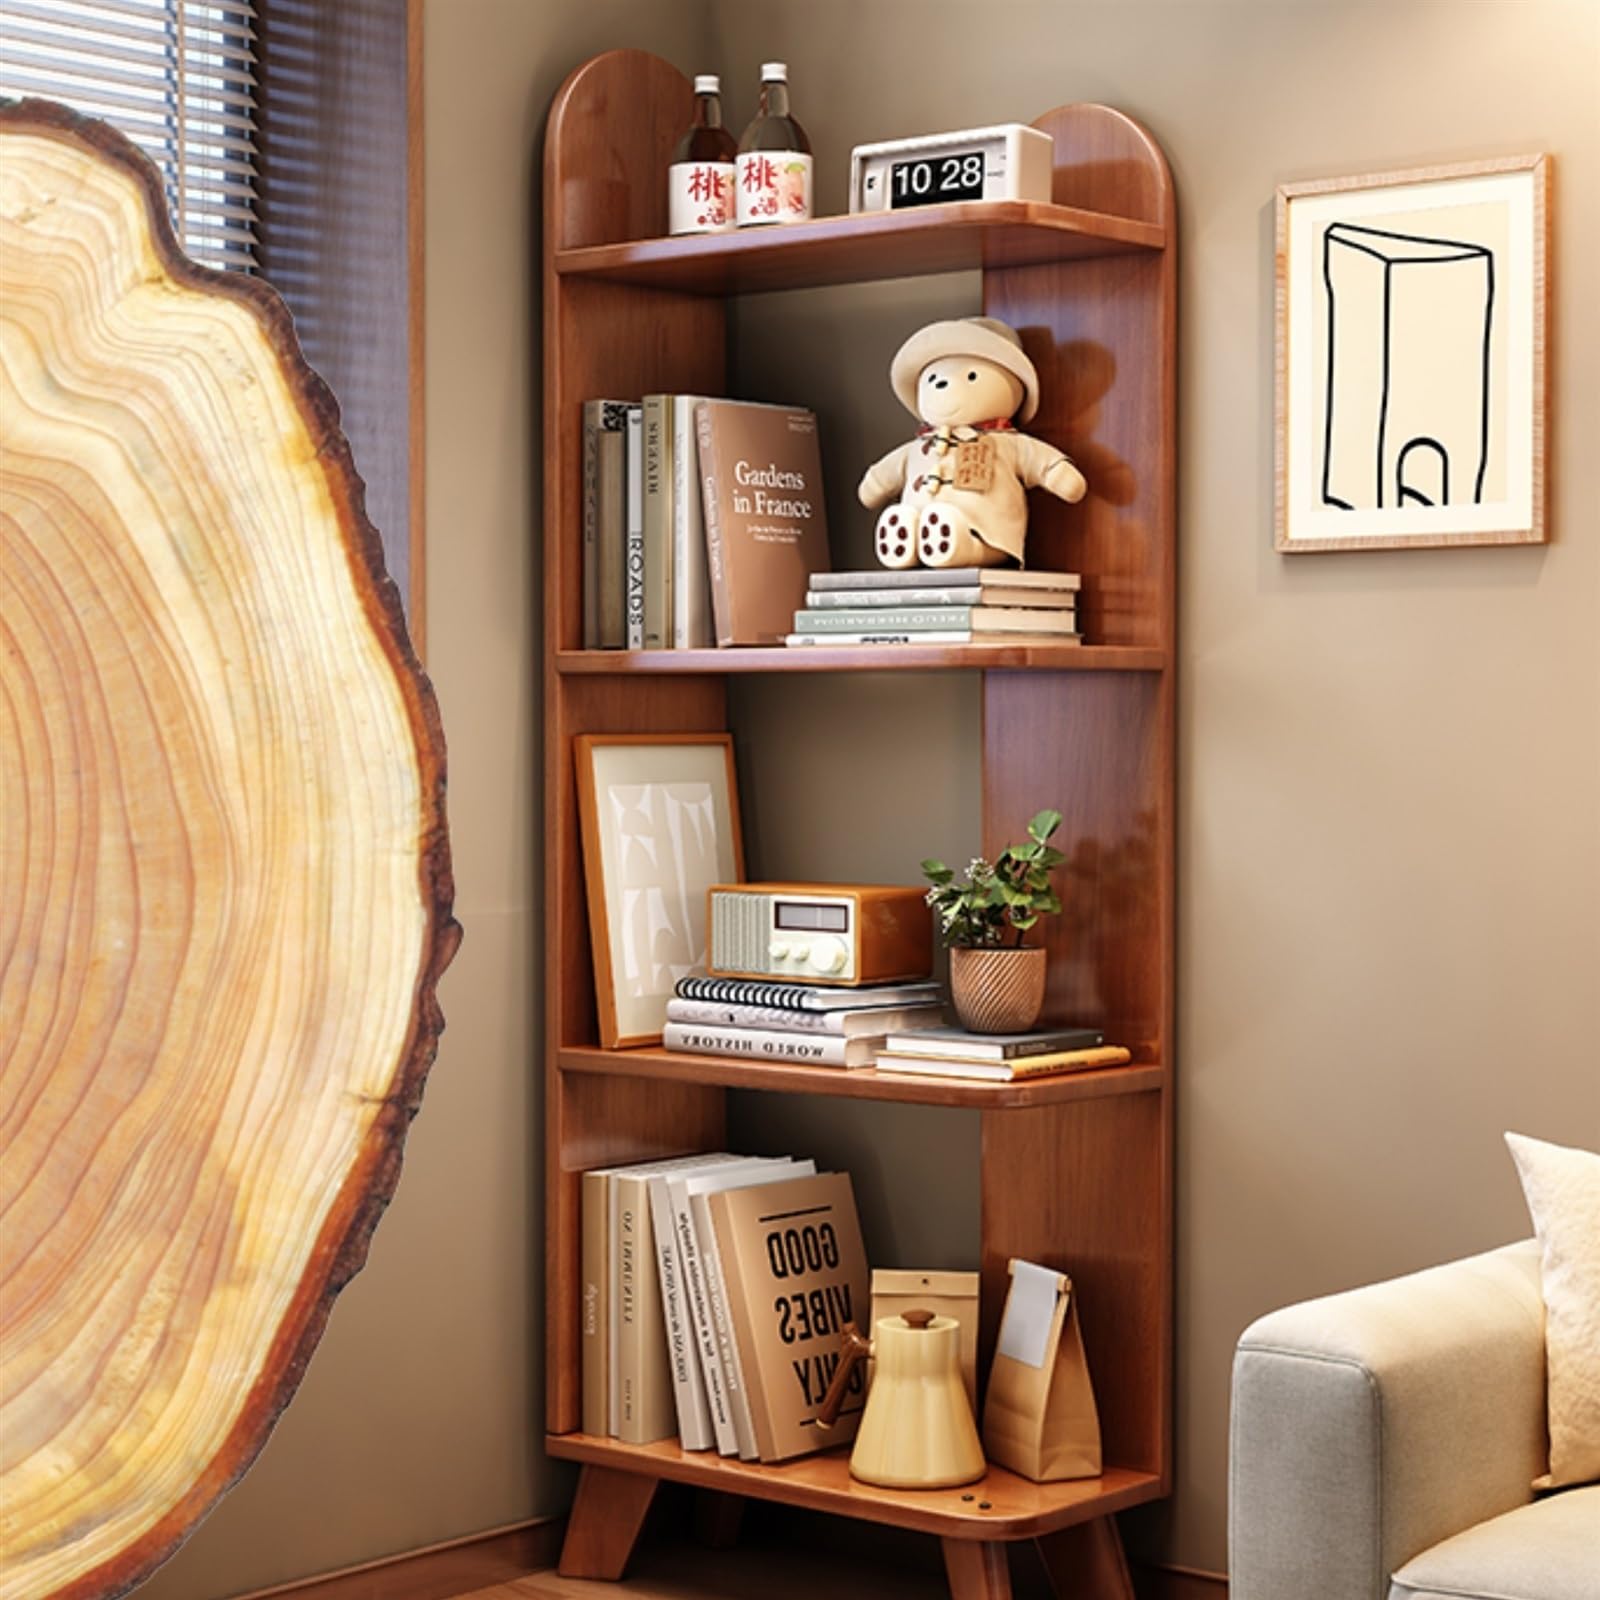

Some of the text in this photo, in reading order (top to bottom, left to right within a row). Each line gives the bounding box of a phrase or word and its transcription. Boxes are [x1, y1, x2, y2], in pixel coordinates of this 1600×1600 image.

[687, 166, 726, 202] 桃
[741, 154, 779, 193] 桃
[895, 156, 981, 196] 10 28
[647, 422, 659, 495] RIVERS
[734, 460, 806, 491] Gardens
[733, 489, 812, 519] in France
[629, 537, 645, 626] ROADS
